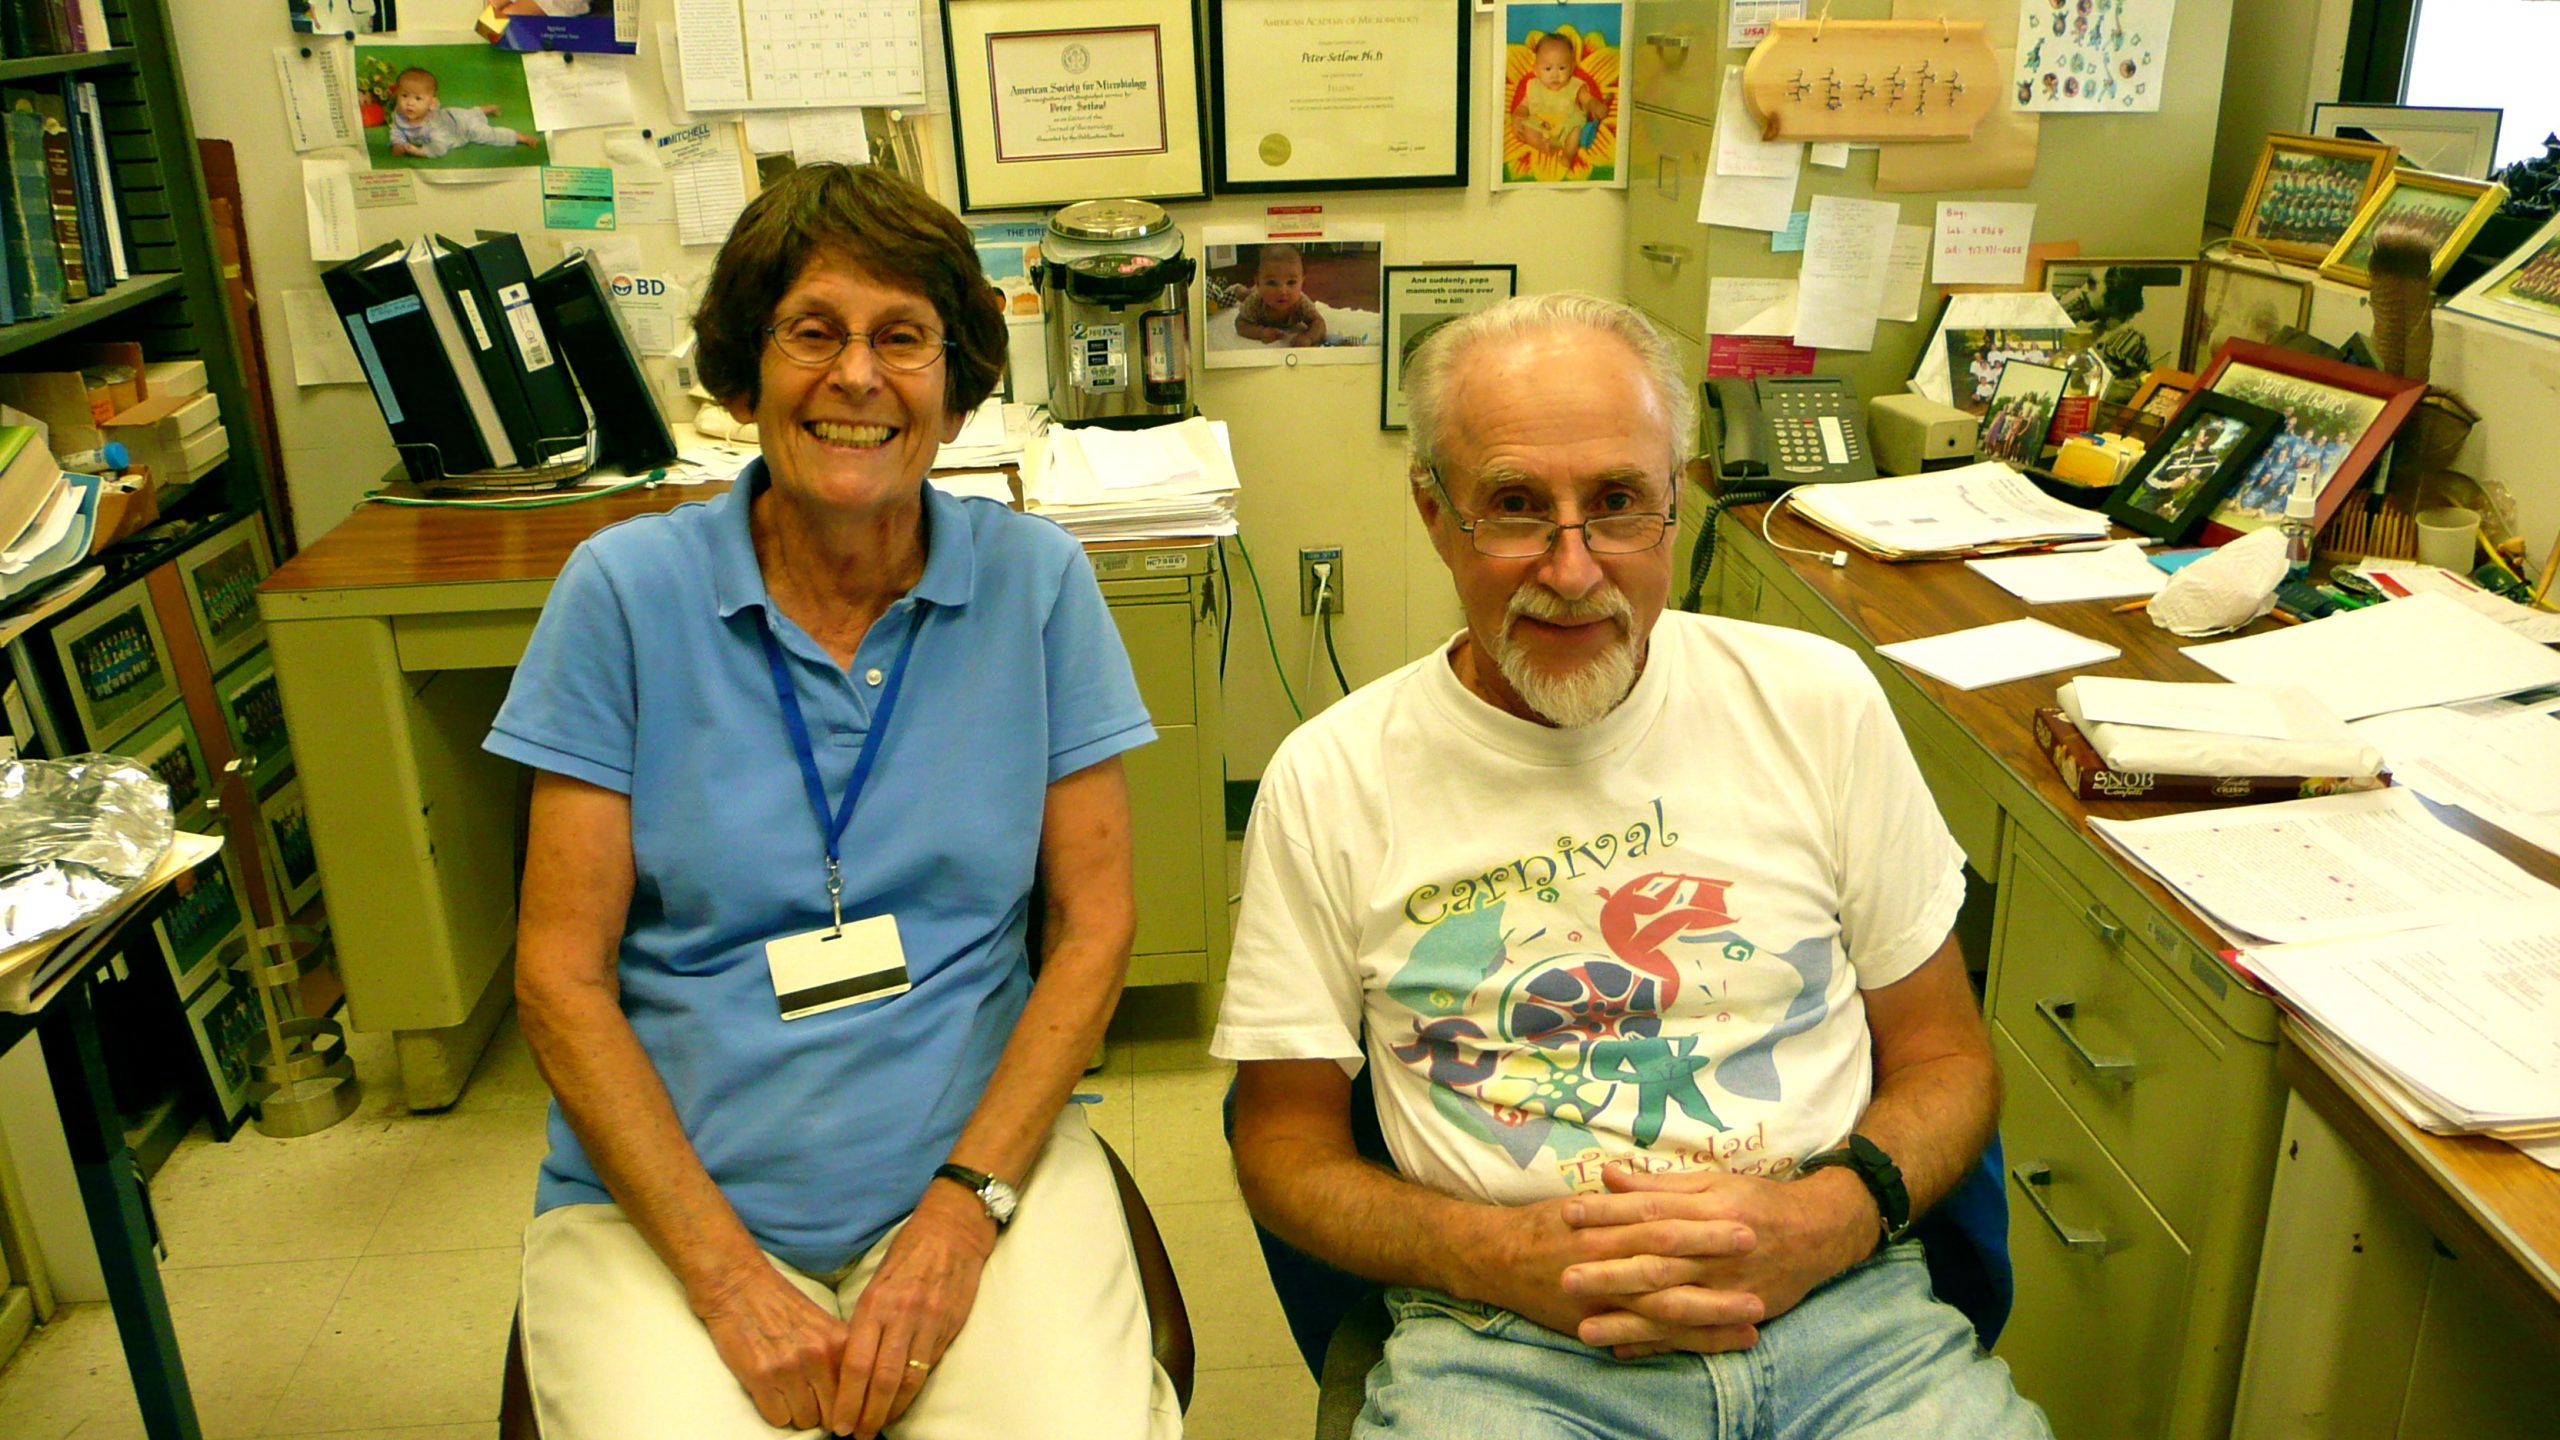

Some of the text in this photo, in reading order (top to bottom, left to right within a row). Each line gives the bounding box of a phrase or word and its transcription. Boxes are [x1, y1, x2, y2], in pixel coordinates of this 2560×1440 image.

[1744, 27, 1765, 36] USA
[1301, 52, 1327, 63] Peter
[1010, 78, 1147, 97] American Society for Microbiology
[1050, 102, 1072, 113] Peter
[667, 124, 710, 144] MITCHELL
[1006, 228, 1024, 237] THE
[635, 278, 665, 296] BD
[1429, 276, 1468, 285] suddenly,
[1469, 277, 1489, 285] papa
[2093, 771, 2154, 788] SNOB
[1404, 796, 1680, 925] Carnival
